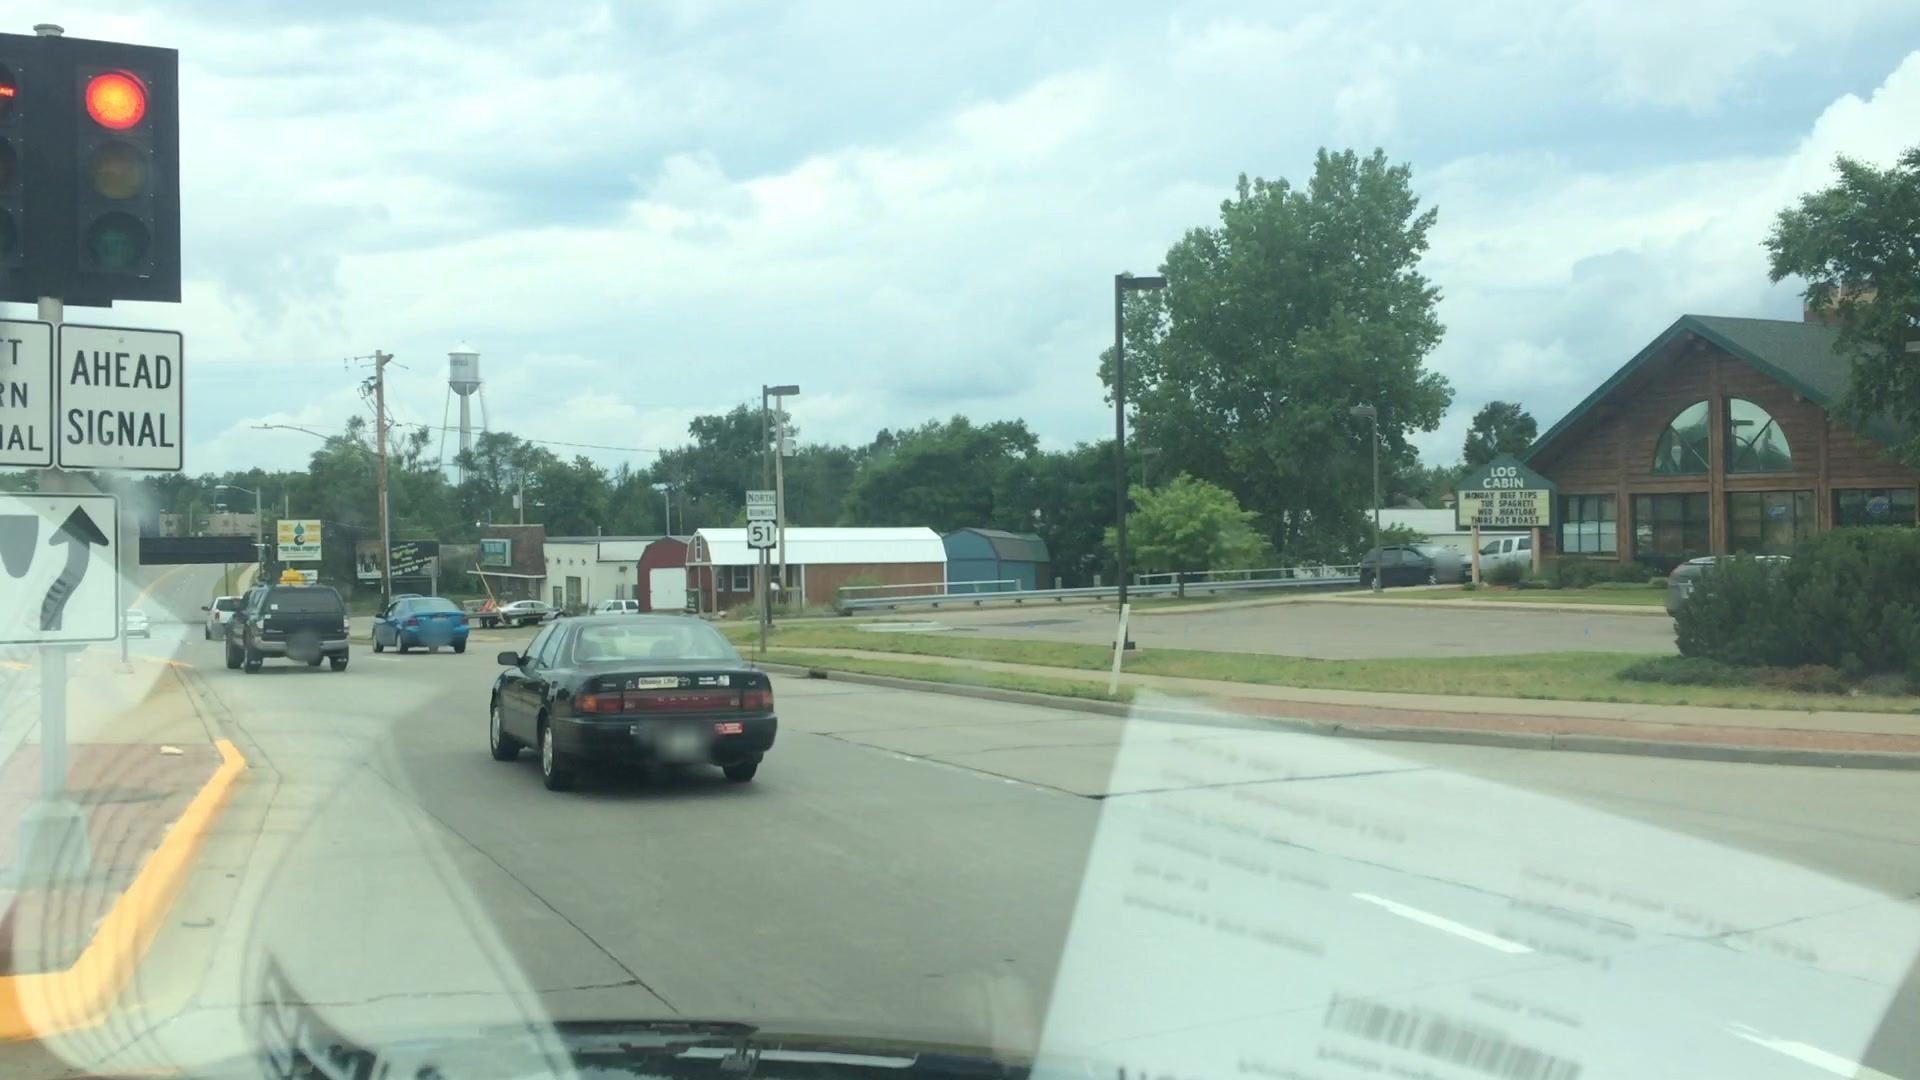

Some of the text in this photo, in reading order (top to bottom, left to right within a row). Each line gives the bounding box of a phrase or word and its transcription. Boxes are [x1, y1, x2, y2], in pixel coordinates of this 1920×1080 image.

[70, 349, 172, 390] AHEAD
[66, 407, 175, 448] SIGNAL
[1490, 466, 1516, 478] LOG
[1483, 478, 1524, 488] CABIN
[748, 494, 776, 502] NORTH
[1464, 492, 1494, 500] MONDAY
[1500, 492, 1516, 500] BEEF
[1495, 516, 1510, 524] POT
[1512, 516, 1540, 524] ROAST
[752, 526, 770, 542] 51
